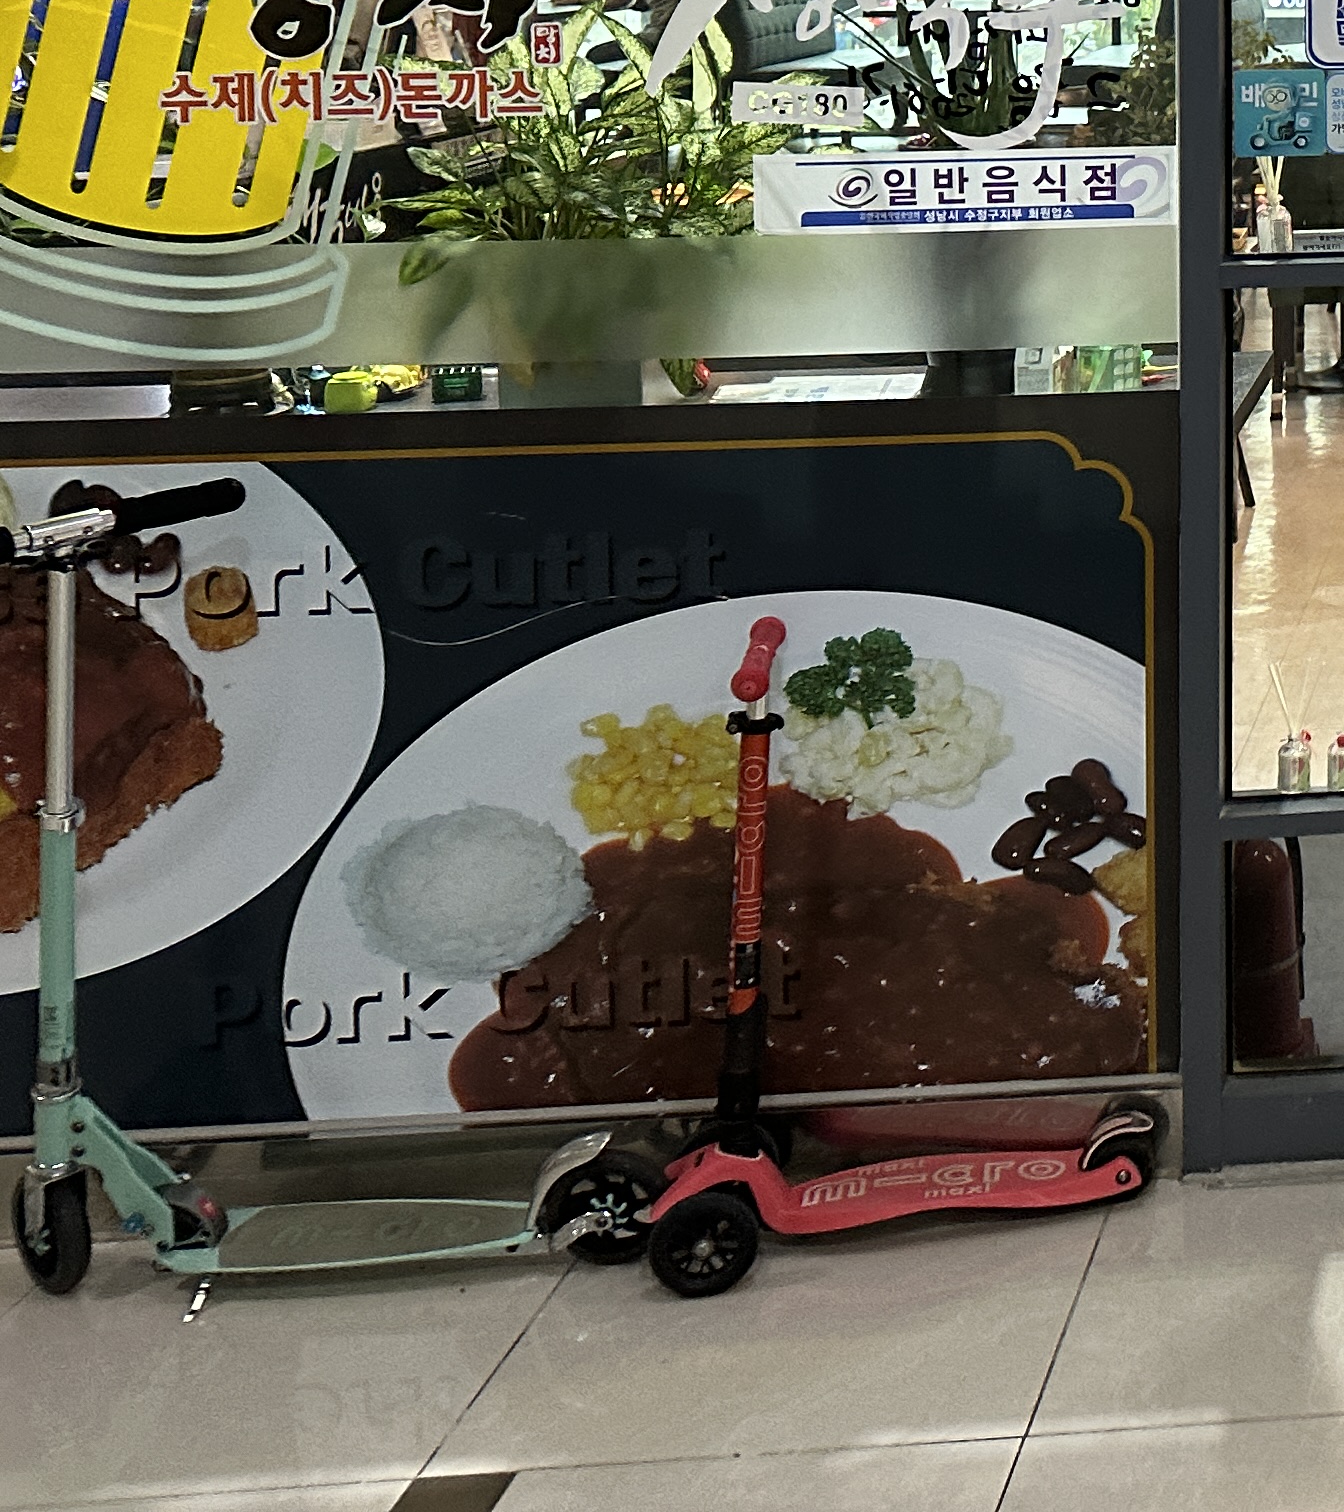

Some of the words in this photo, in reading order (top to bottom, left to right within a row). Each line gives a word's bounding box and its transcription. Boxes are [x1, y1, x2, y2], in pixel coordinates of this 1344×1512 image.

[160, 68, 544, 124] 수제(치즈)돈까스
[884, 163, 1118, 206] 일반음식점
[924, 209, 959, 221] 성남시
